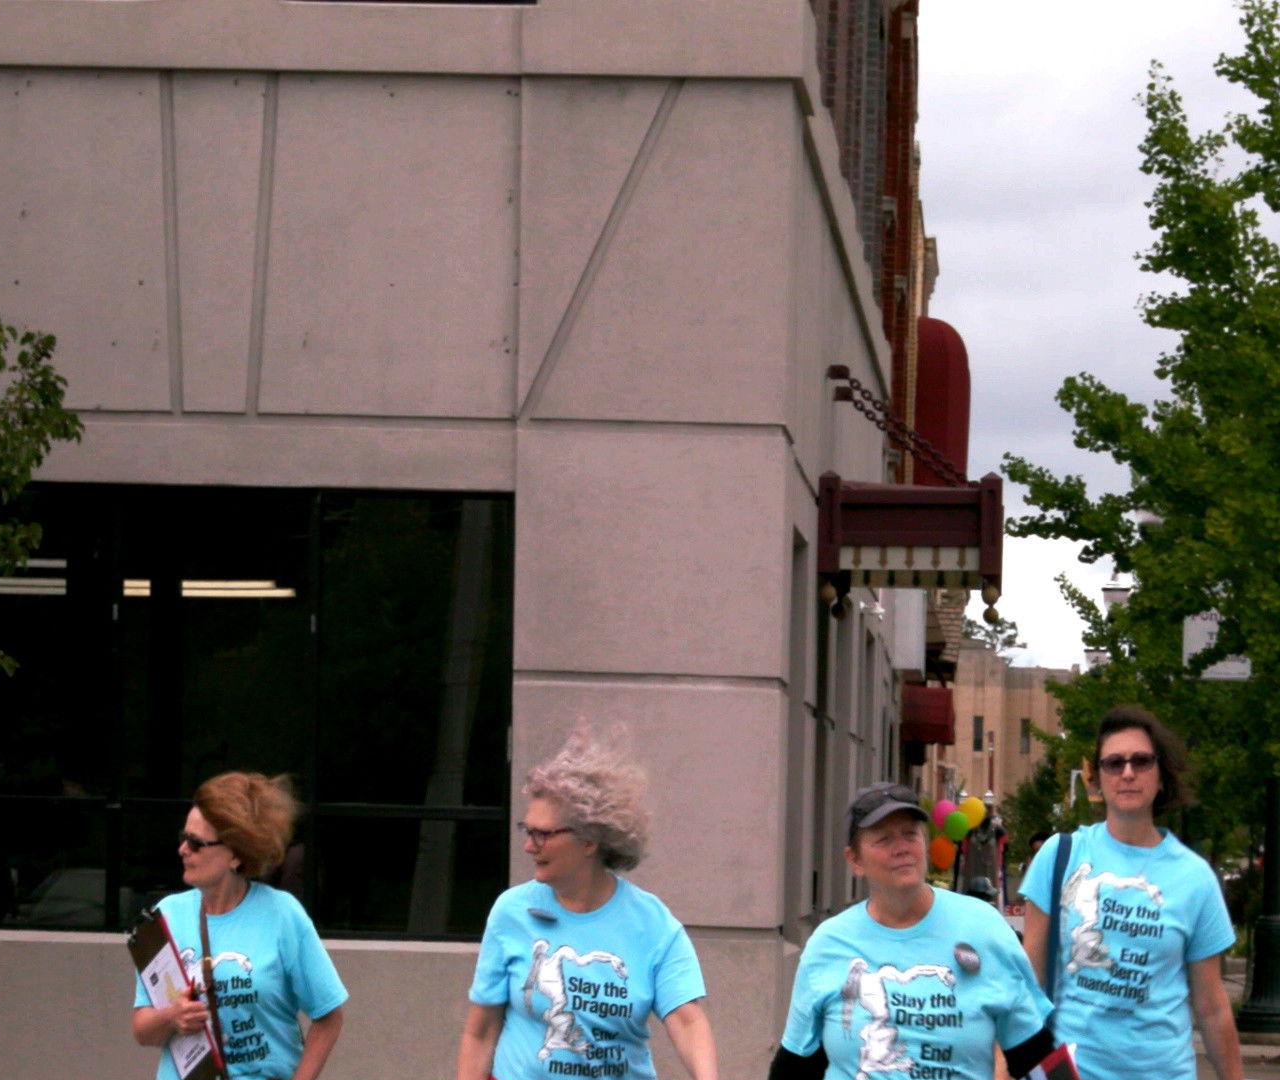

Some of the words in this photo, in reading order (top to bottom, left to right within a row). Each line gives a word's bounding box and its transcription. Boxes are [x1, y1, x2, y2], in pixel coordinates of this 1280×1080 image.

[1101, 897, 1133, 919] Slay
[1136, 904, 1161, 920] the
[1102, 914, 1164, 939] Dragon!
[1120, 947, 1149, 966] End
[231, 976, 252, 989] the
[567, 976, 600, 998] Slay
[604, 982, 628, 999] the
[1076, 975, 1150, 1003] mandering!
[572, 995, 634, 1019] Dragon!
[890, 992, 926, 1011] Slay
[930, 993, 957, 1009] the
[231, 1015, 256, 1034] End
[895, 1008, 963, 1031] Dragon!
[920, 1042, 953, 1062] End
[548, 1059, 629, 1079] mandering!
